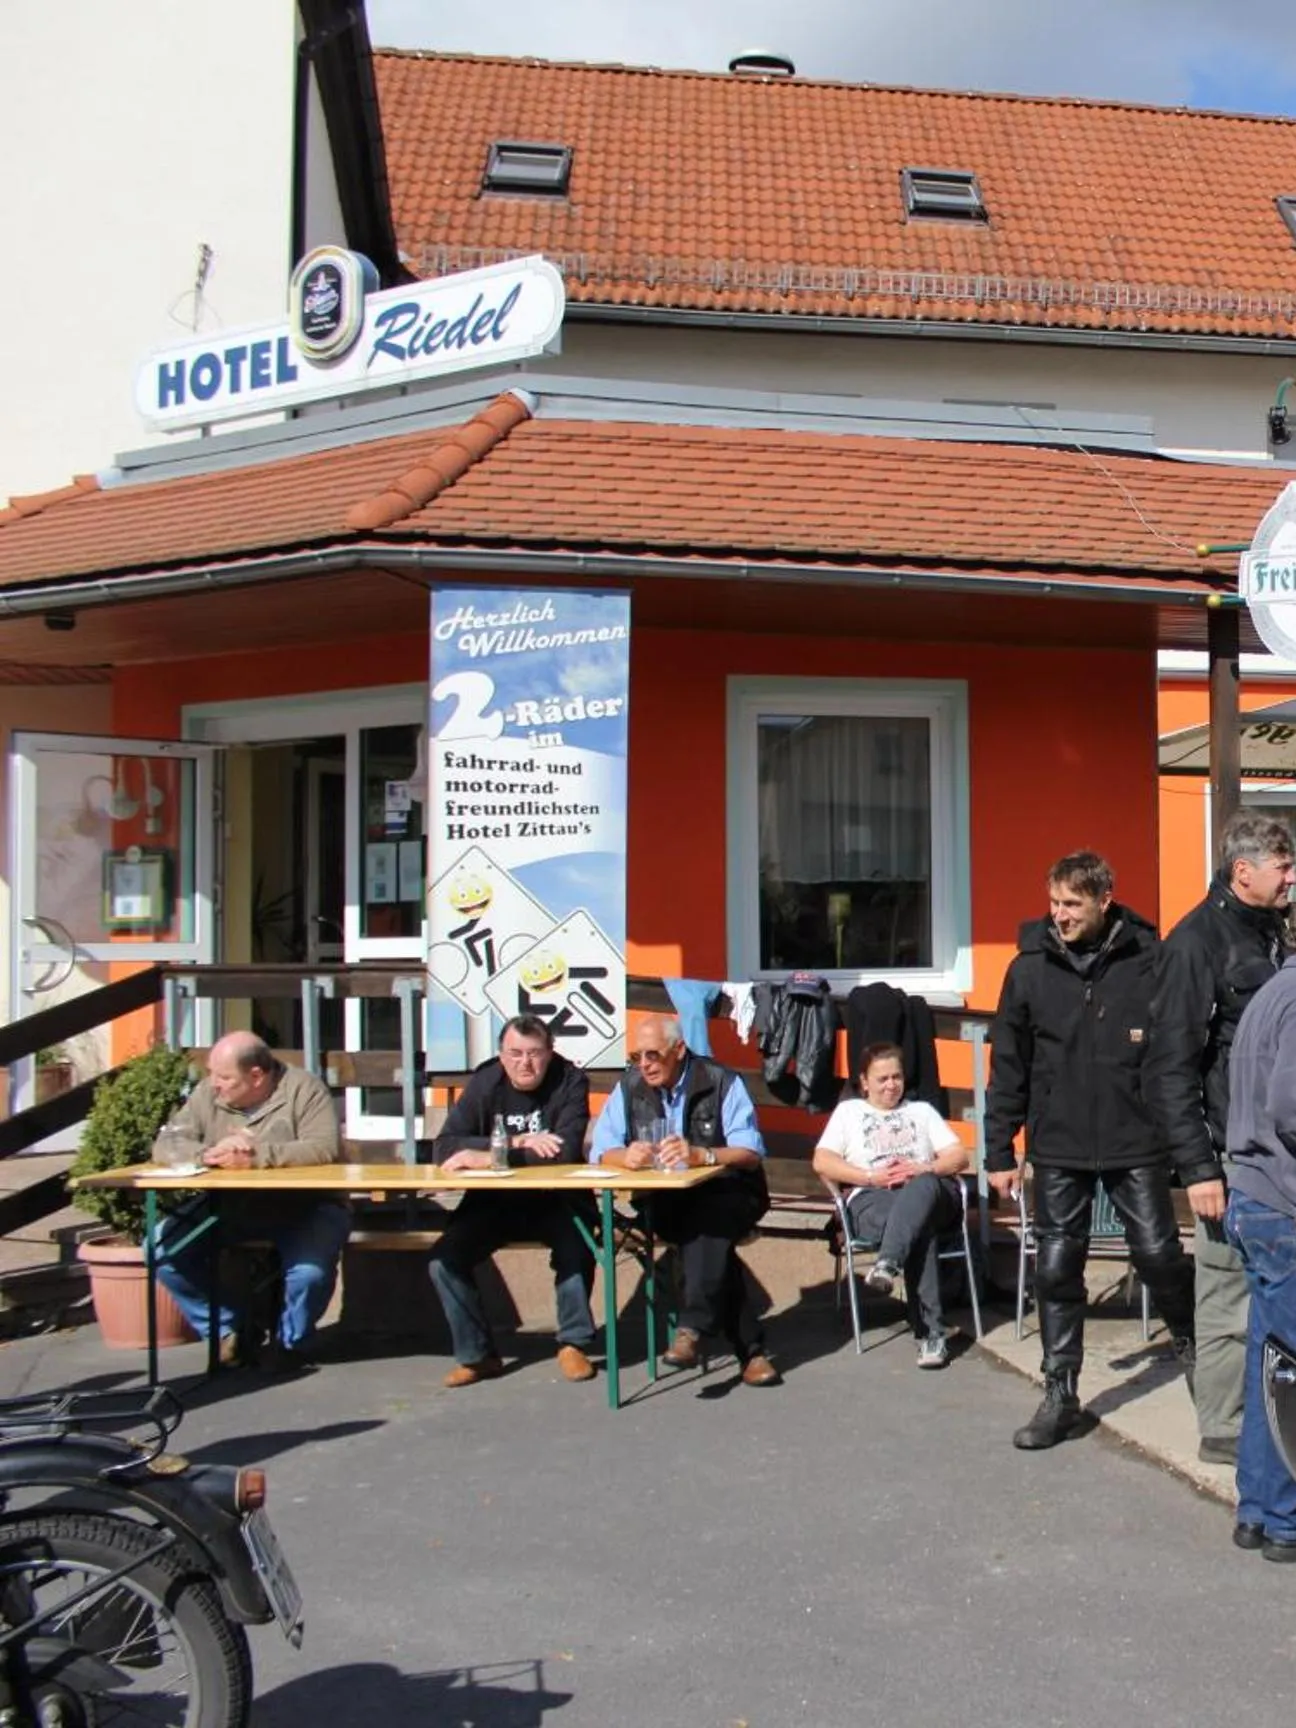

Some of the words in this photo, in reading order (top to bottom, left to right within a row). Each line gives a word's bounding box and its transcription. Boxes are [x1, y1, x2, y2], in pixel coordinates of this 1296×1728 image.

[157, 335, 298, 409] HOTEL
[367, 282, 524, 369] Riedel
[435, 598, 557, 641] Herzlich
[458, 625, 628, 658] Willkommen
[528, 730, 565, 750] im
[443, 751, 541, 774] fahrrad-
[547, 762, 583, 776] und
[444, 779, 560, 795] motorrad-
[446, 799, 600, 817] freundlichsten
[446, 822, 511, 841] Hotel
[517, 820, 592, 838] Zittau's
